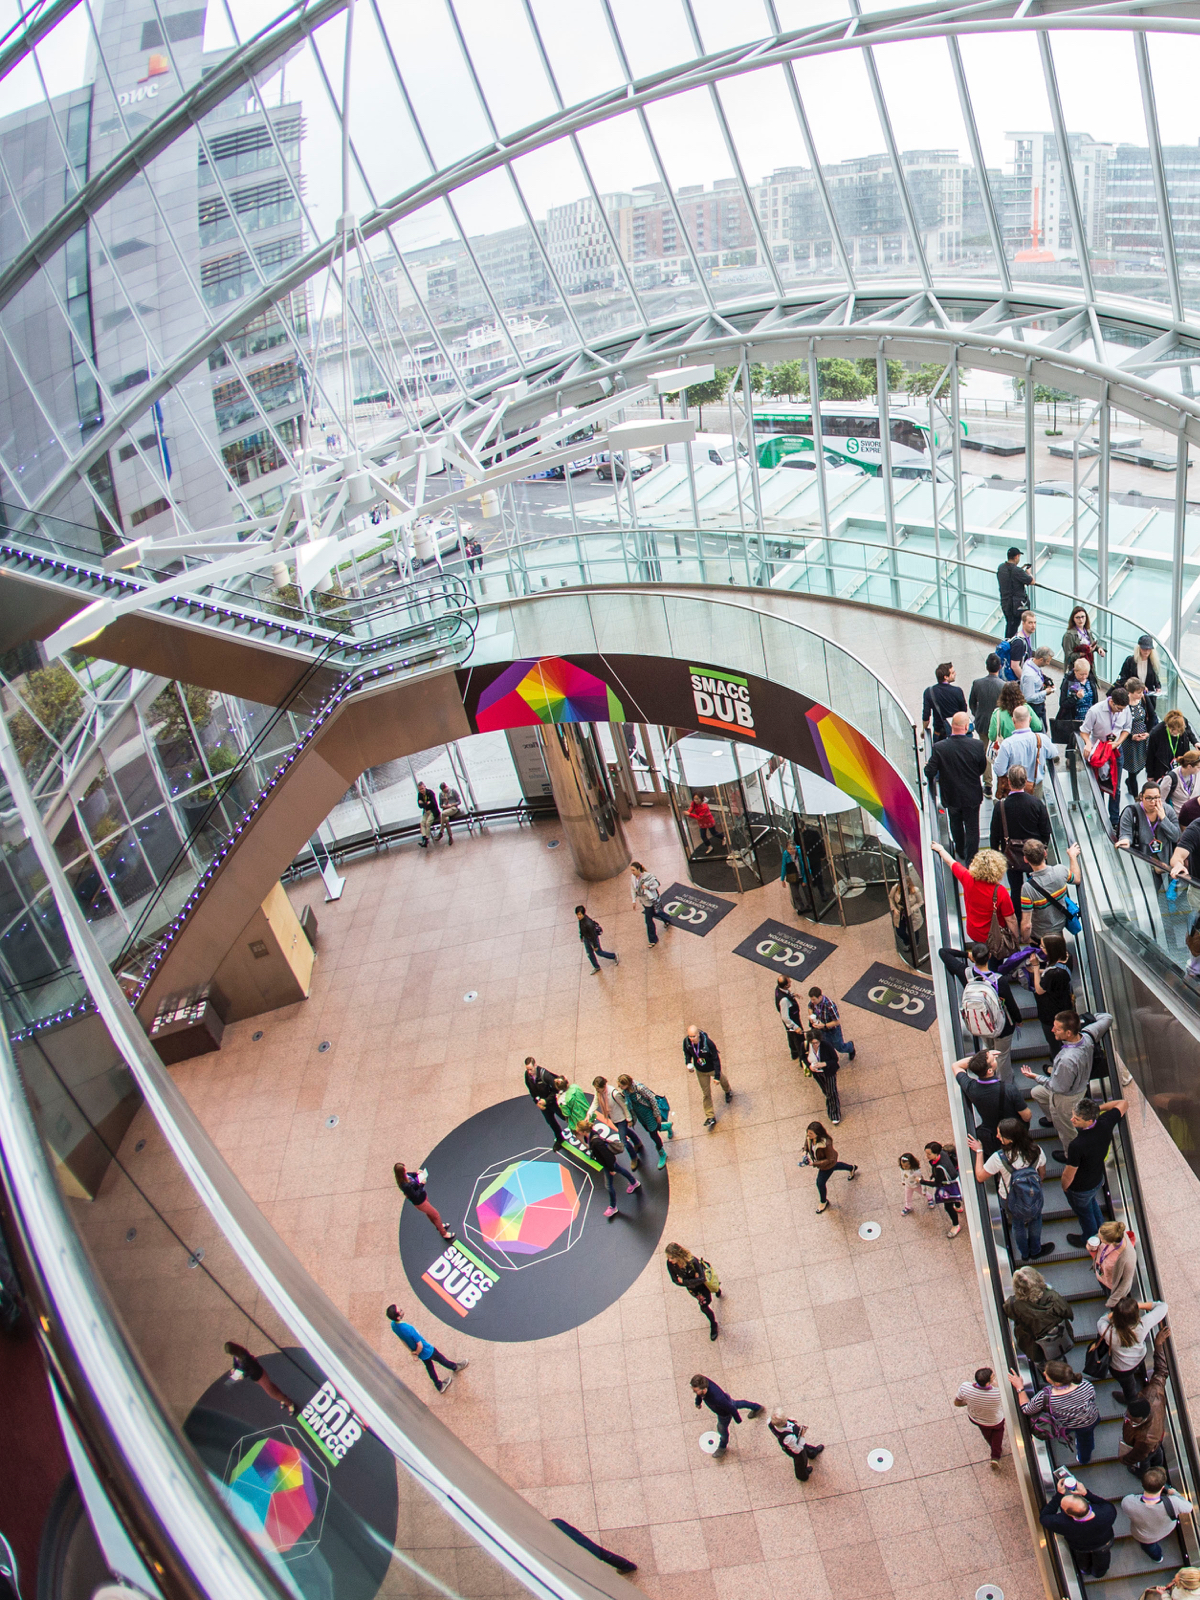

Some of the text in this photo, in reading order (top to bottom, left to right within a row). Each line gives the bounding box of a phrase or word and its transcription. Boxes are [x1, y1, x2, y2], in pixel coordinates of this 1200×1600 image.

[114, 83, 158, 113] pwc
[691, 675, 750, 702] SMACC
[693, 690, 754, 728] DUB
[756, 940, 805, 967] CCD
[868, 986, 925, 1015] CCD
[879, 978, 919, 996] CONVENTION
[427, 1255, 482, 1309] DUB
[444, 1246, 493, 1292] SMACC
